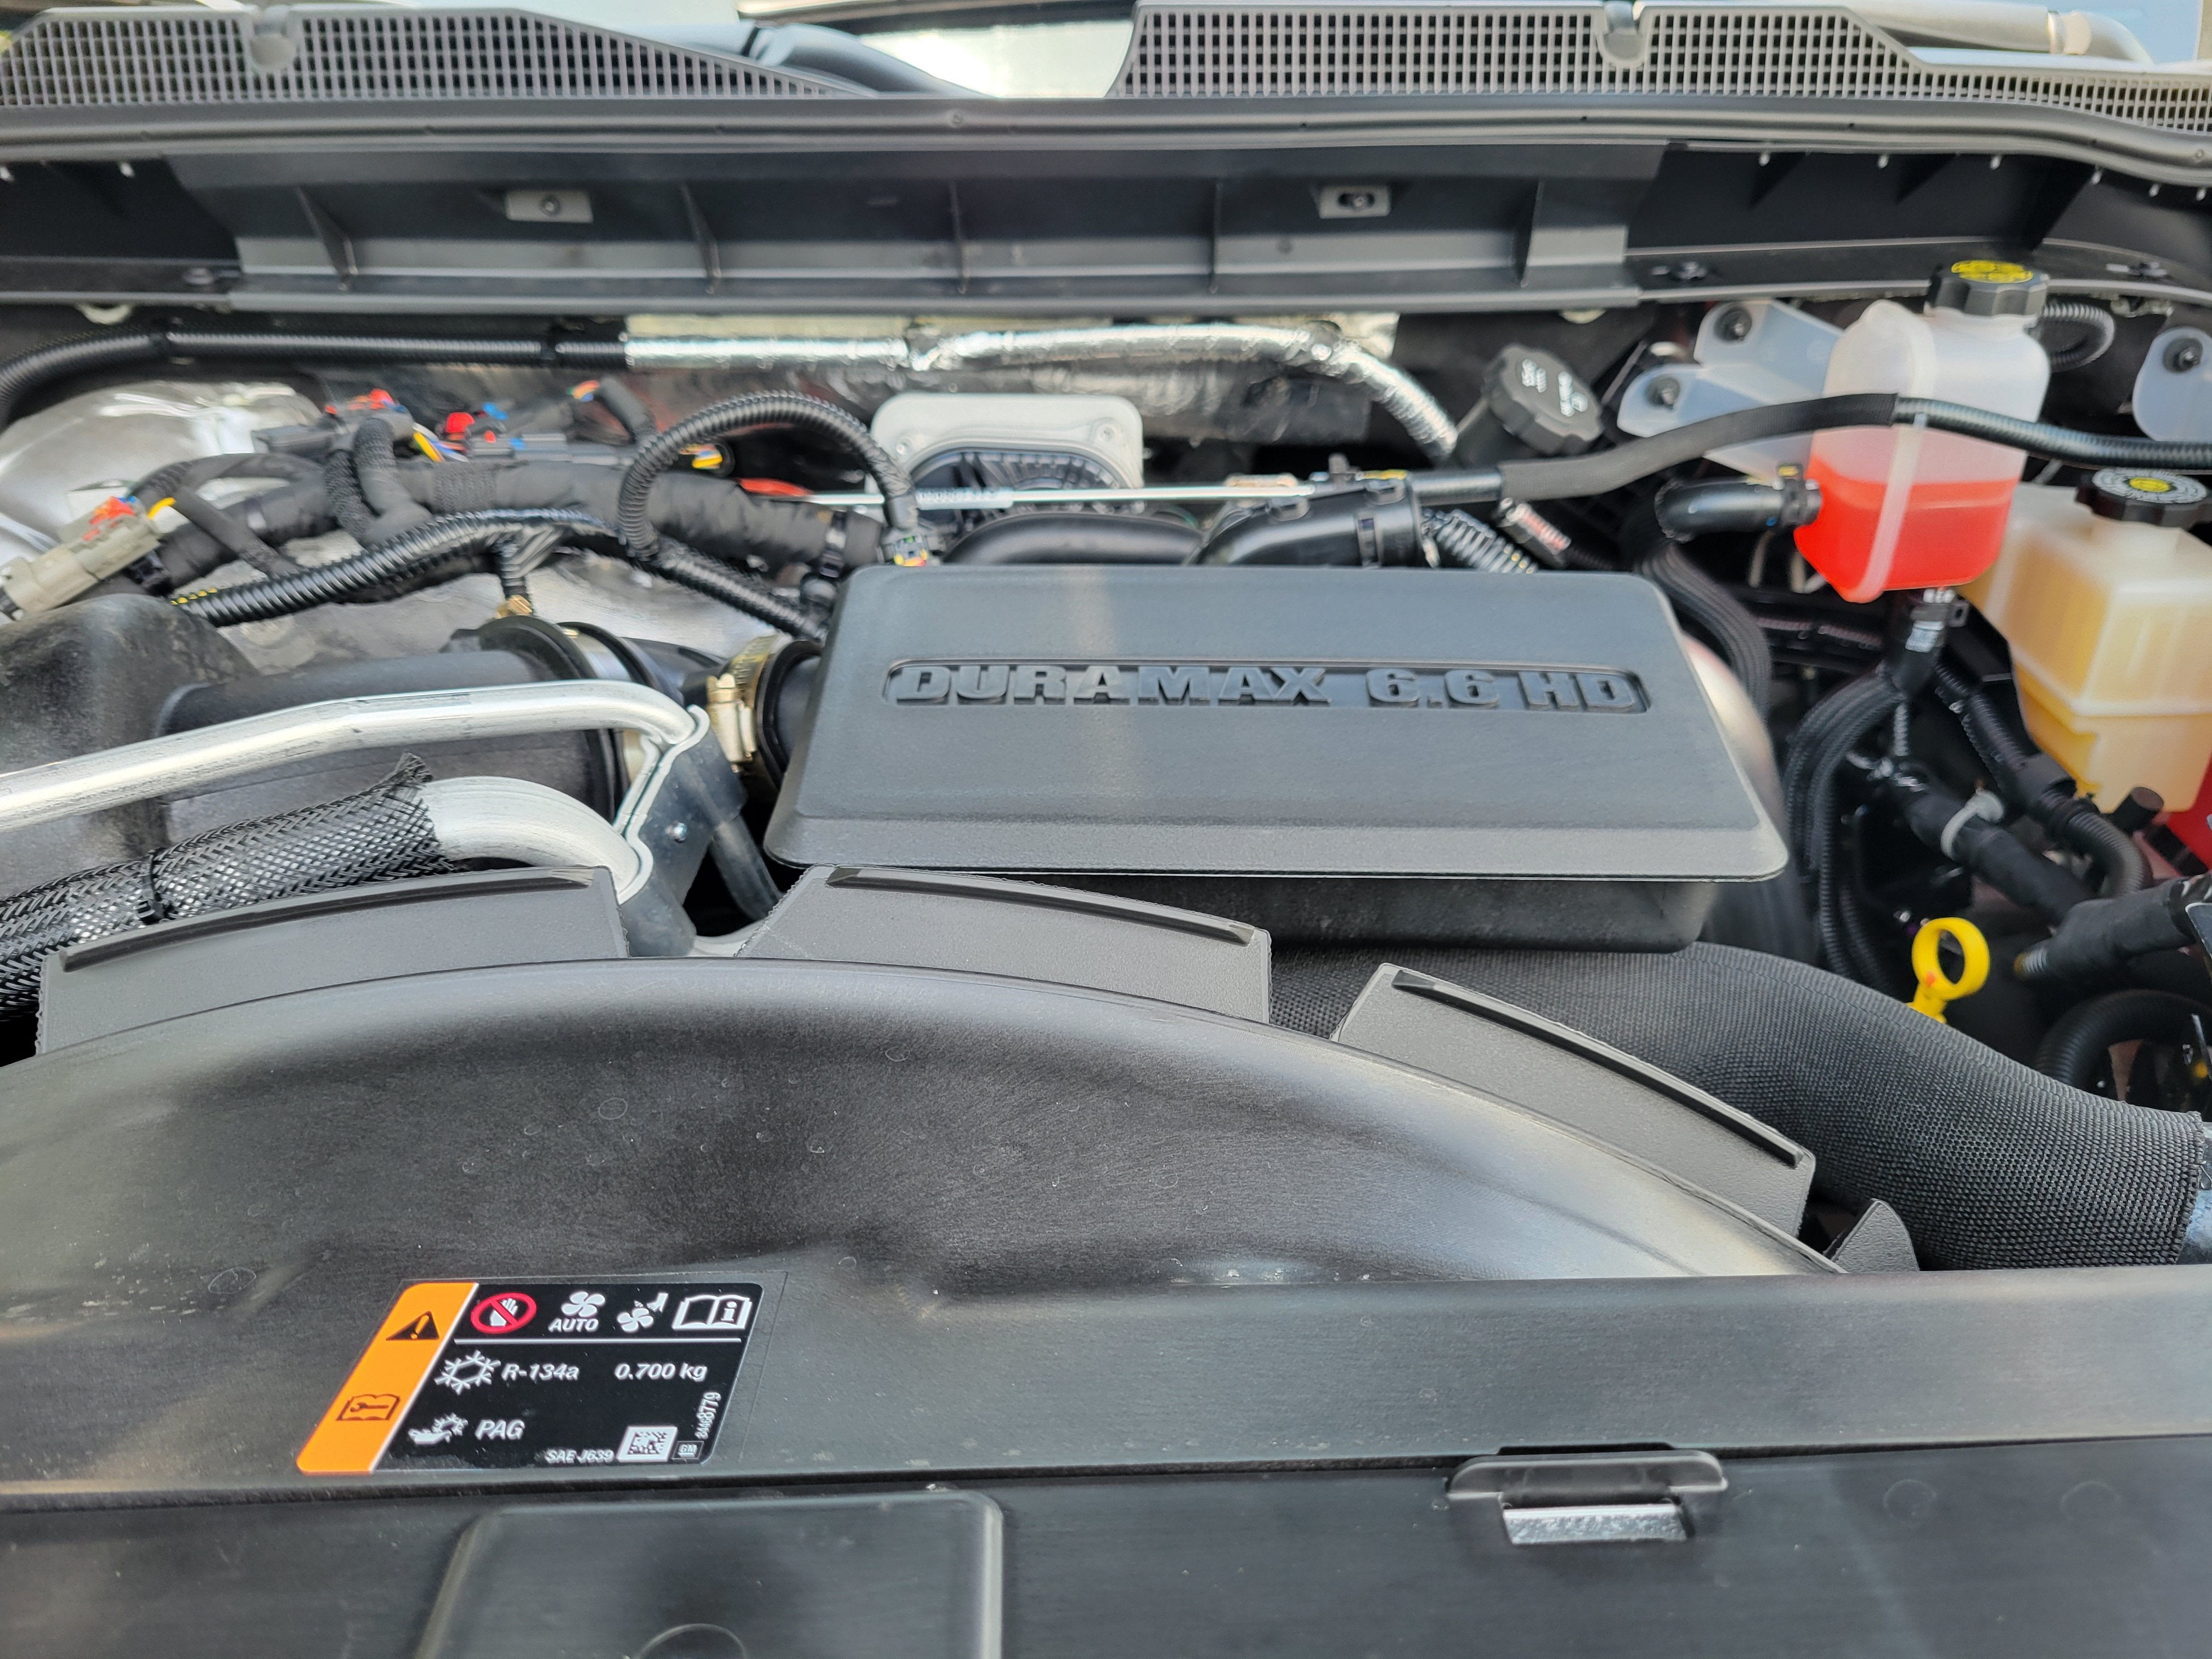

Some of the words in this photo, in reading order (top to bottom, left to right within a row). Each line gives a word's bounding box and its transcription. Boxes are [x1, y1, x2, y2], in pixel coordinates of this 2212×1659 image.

[896, 665, 1331, 705] DURAMAX
[1366, 668, 1500, 708] 6.6
[1518, 670, 1635, 710] HD
[548, 1318, 599, 1333] AUTO
[501, 1363, 579, 1380] R-134a
[614, 1363, 675, 1380] 0.700
[679, 1363, 707, 1382] kg
[476, 1419, 525, 1440] PAG
[545, 1449, 576, 1463] SAE
[577, 1449, 614, 1463] J639
